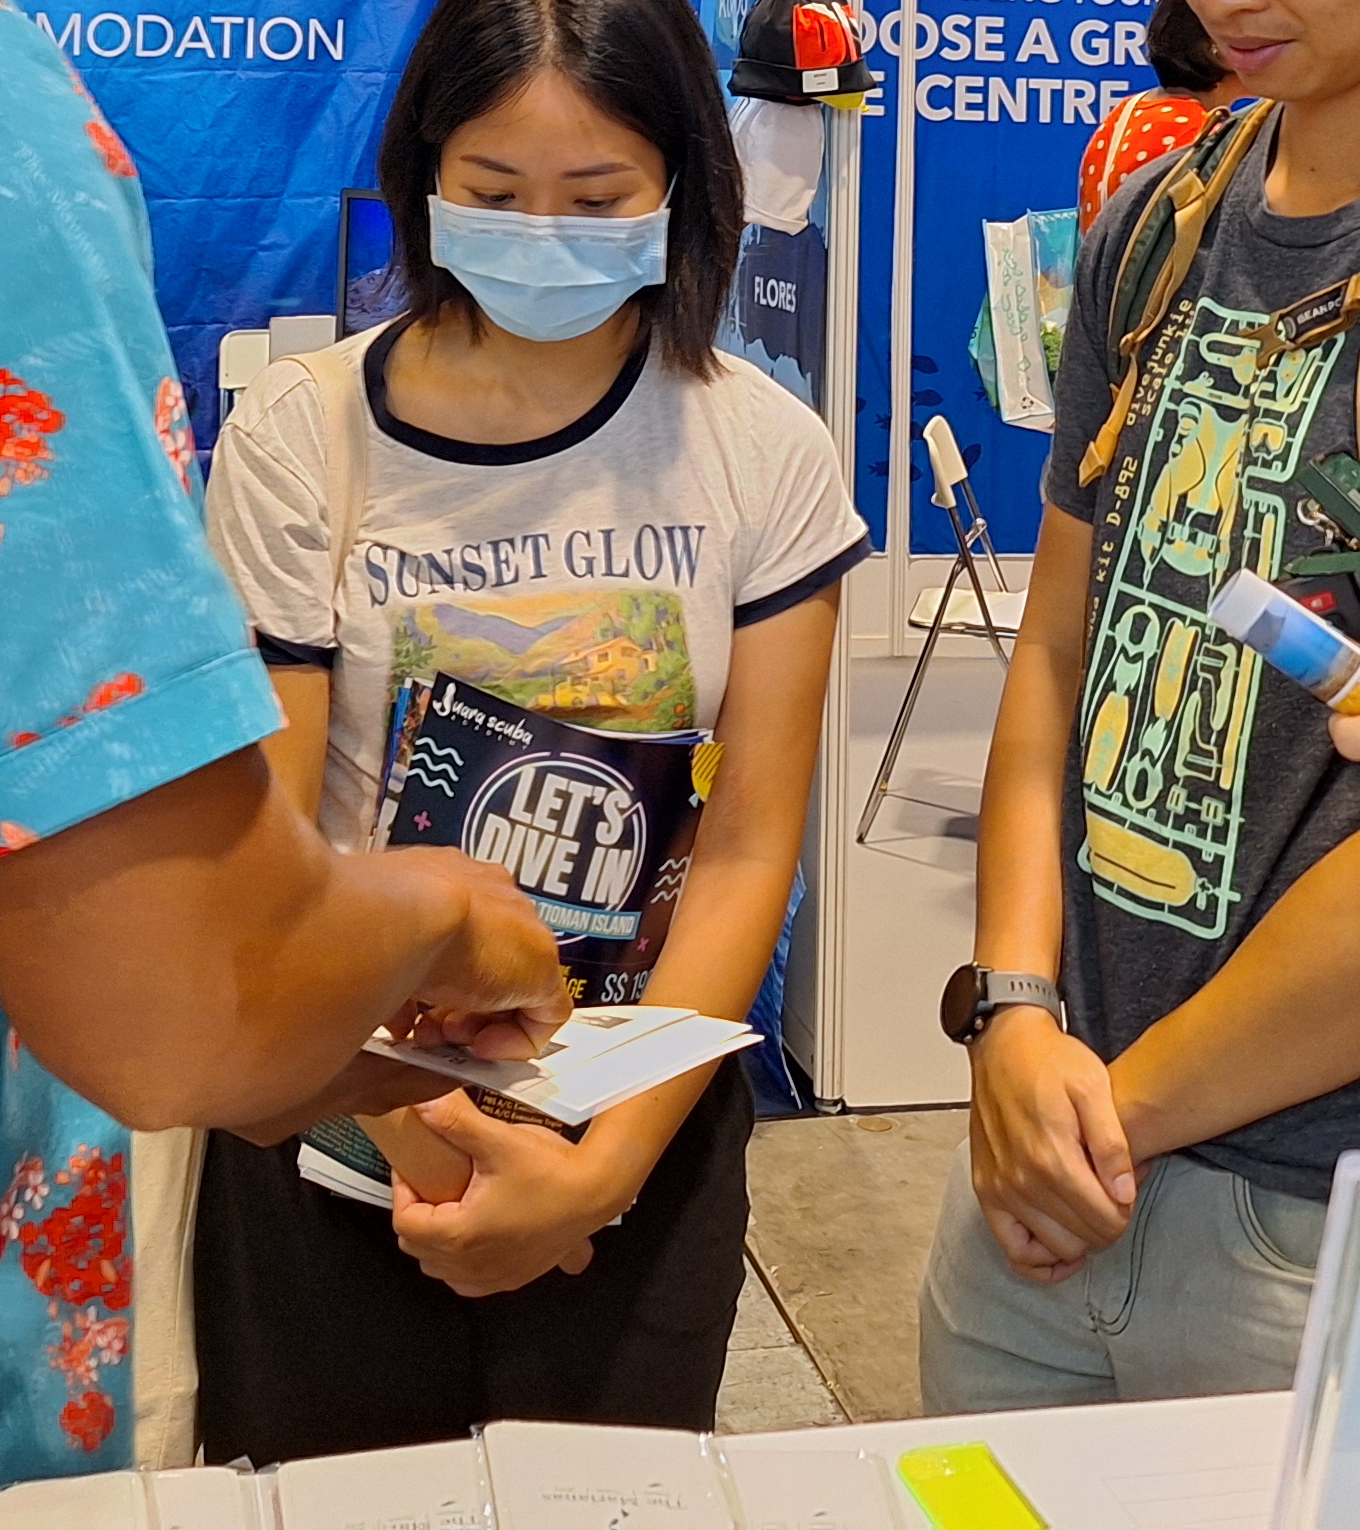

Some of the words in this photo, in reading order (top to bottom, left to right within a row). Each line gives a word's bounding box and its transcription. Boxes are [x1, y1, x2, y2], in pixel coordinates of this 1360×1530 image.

[1015, 18, 1059, 64] A
[754, 275, 797, 314] FLORES
[364, 534, 552, 608] SUNSET
[563, 524, 706, 589] GLOW
[509, 765, 633, 846] LET'S
[475, 812, 581, 897] DIVE
[580, 846, 634, 905] IN
[591, 912, 635, 936] ISLAND
